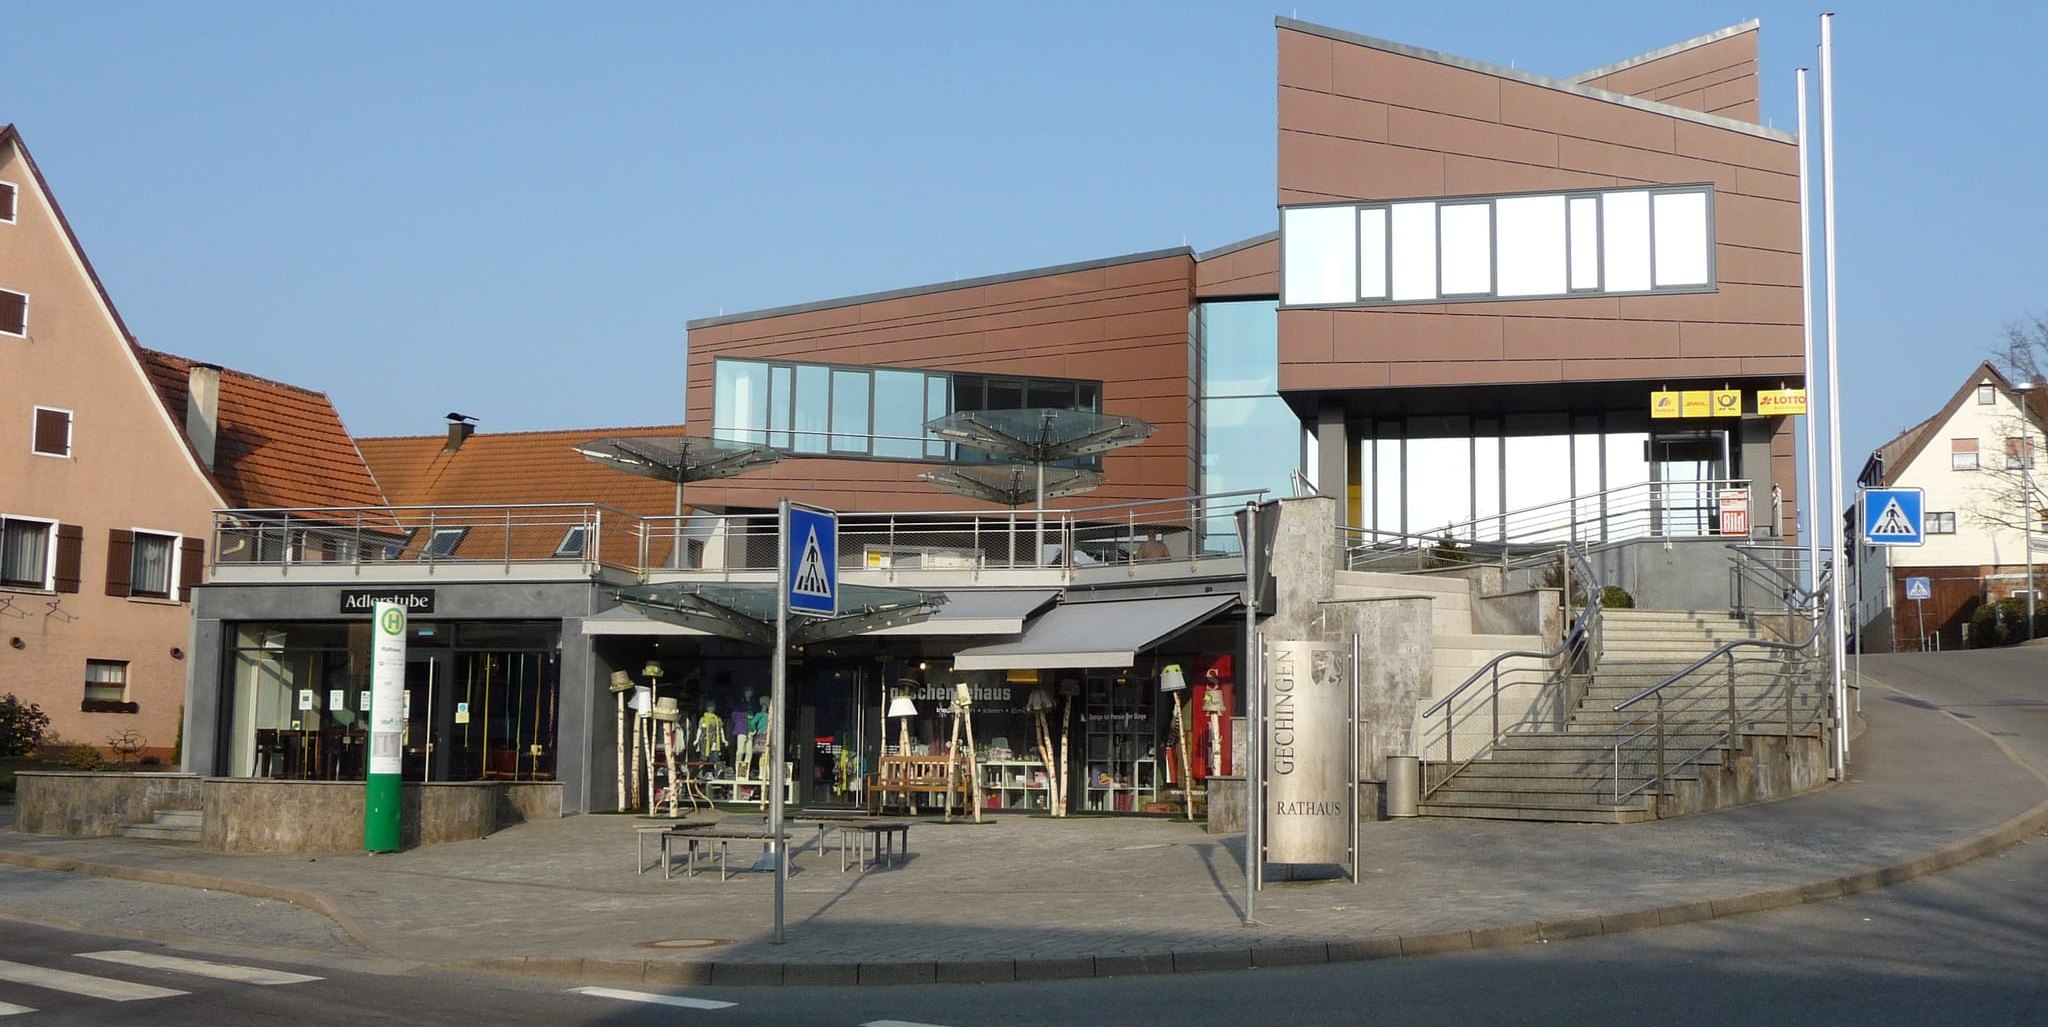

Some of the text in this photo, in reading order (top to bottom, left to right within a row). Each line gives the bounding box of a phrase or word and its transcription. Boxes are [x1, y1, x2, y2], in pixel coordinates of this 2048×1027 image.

[1774, 396, 1806, 405] LOTTO
[1723, 512, 1745, 532] Bild
[1273, 649, 1296, 776] GECHINGEN
[1277, 801, 1342, 816] RATHAUS
